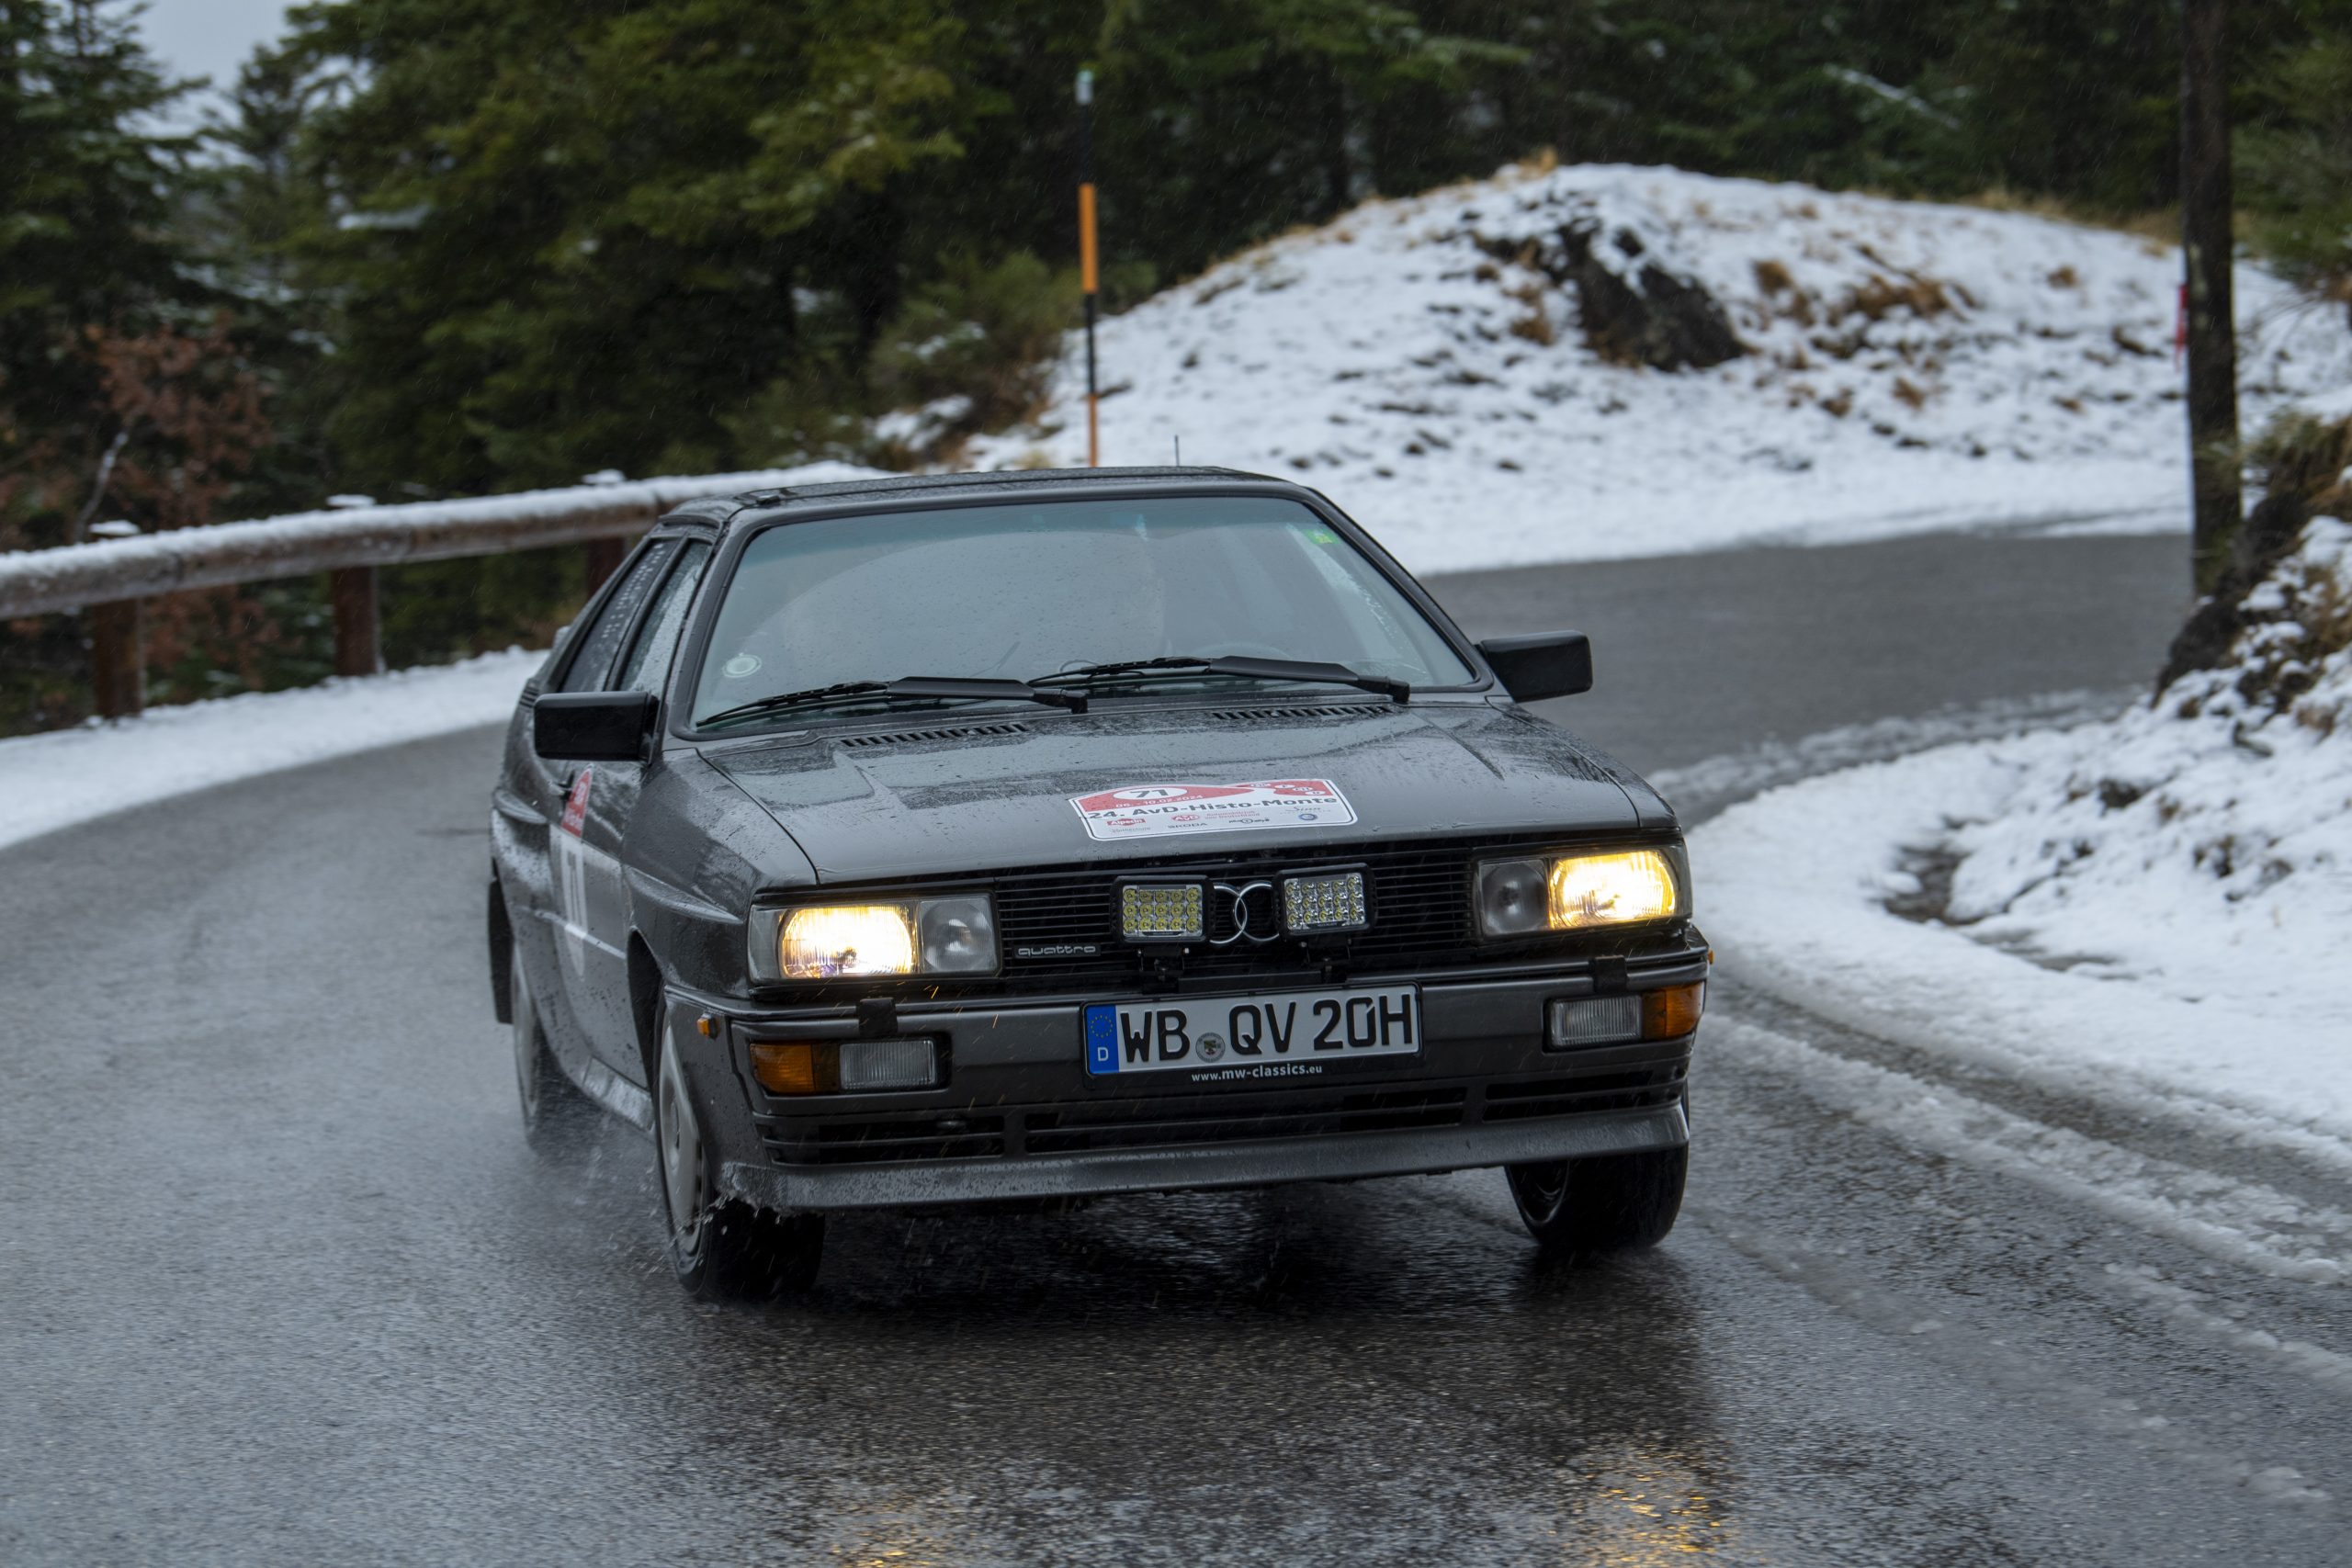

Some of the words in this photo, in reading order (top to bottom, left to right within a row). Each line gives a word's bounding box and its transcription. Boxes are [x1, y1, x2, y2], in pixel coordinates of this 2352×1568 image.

[1130, 789, 1170, 798] 71
[1088, 811, 1125, 819] 24.
[1132, 798, 1337, 816] AvD-Histo-Monte
[1018, 945, 1096, 957] quattro
[1120, 1009, 1191, 1063] WB
[1228, 1001, 1296, 1055] QV
[1313, 993, 1413, 1051] 20H
[1097, 1046, 1109, 1062] D
[1192, 1063, 1323, 1082] www.mw-classics.eu
